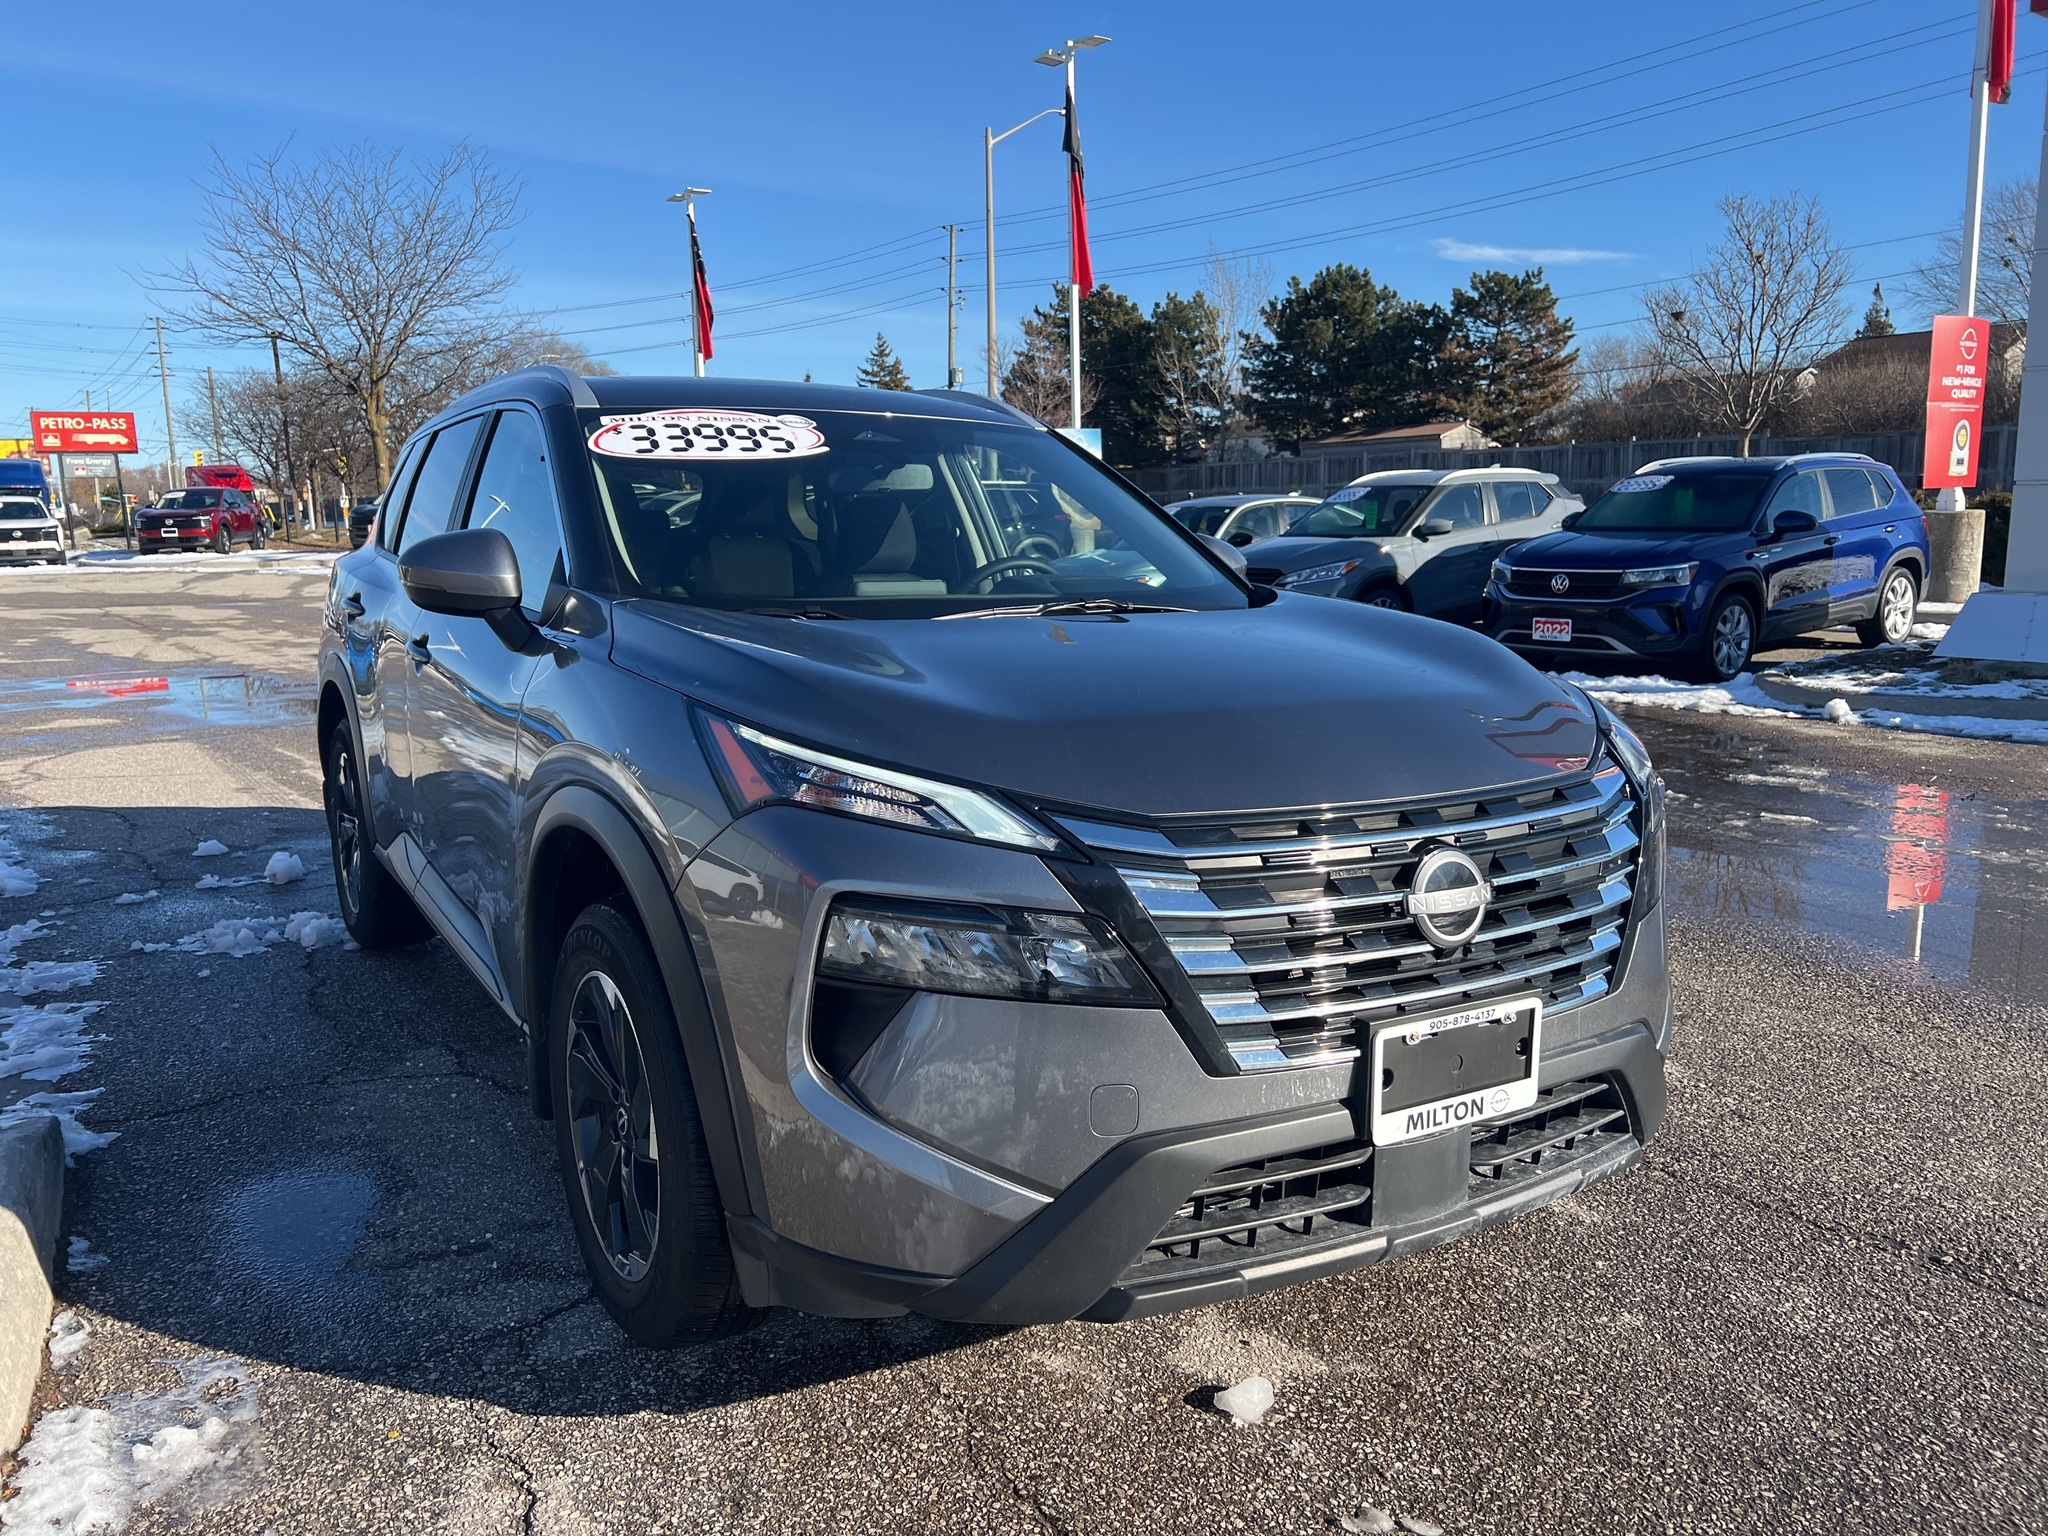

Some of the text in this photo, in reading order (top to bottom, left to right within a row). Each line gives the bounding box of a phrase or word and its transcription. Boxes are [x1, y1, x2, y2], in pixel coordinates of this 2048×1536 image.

[1964, 365, 1976, 375] FOR
[1951, 388, 1977, 399] QUALITY
[39, 417, 127, 430] PETRO-PASS
[609, 415, 771, 424] MILTON NISSAN
[1535, 623, 1569, 635] 2022
[1411, 885, 1492, 912] NISSAN
[567, 929, 612, 958] DUNLOP
[1429, 1009, 1496, 1031] 905-878-4137
[1406, 1096, 1484, 1134] MILTON
